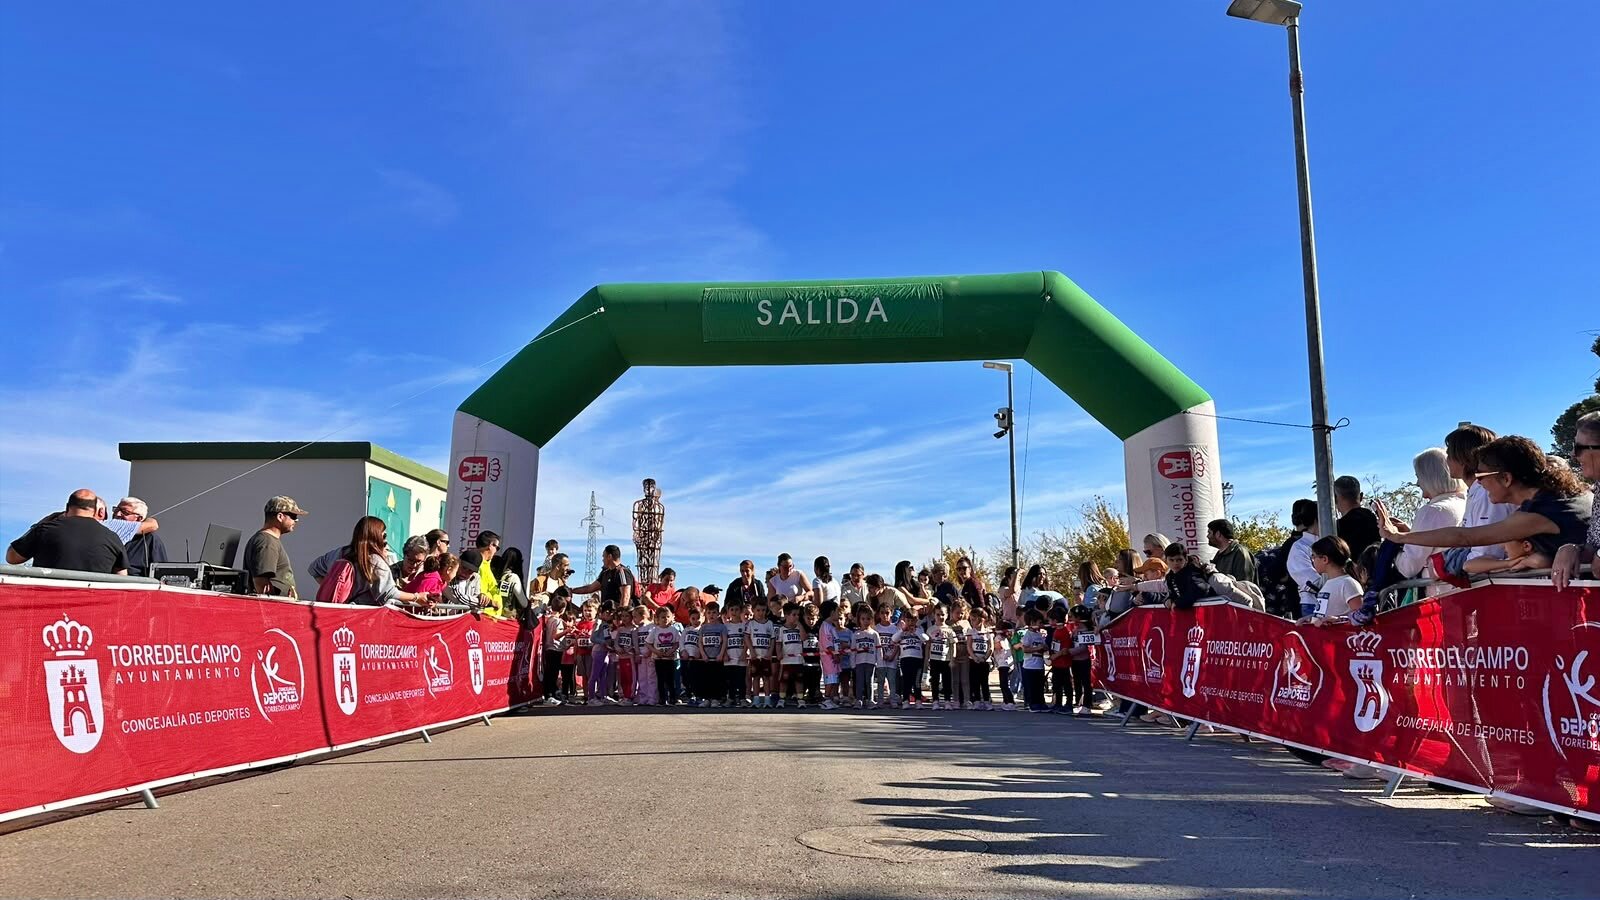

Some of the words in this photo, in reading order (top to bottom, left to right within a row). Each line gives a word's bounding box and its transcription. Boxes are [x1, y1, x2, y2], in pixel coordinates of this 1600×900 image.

[756, 296, 889, 326] SALIDA
[108, 644, 241, 666] TORREDELCAMPO
[360, 644, 417, 659] TORREDELCAMPO
[1206, 640, 1273, 659] TORREDELCAMPO
[1388, 646, 1529, 670] TORREDELCAMPO
[1205, 657, 1269, 670] AYUNTAMIENTO
[115, 667, 240, 684] AYUNTAMIENTO
[1392, 672, 1526, 690] AYUNTAMIENTO
[262, 690, 299, 705] DEPORTES
[121, 712, 187, 733] CONCEJALÍA
[189, 712, 202, 724] DE
[205, 707, 250, 722] DEPORTES
[1560, 716, 1600, 738] DEPO
[1457, 724, 1471, 736] DE
[1474, 724, 1534, 744] DEPORTES
